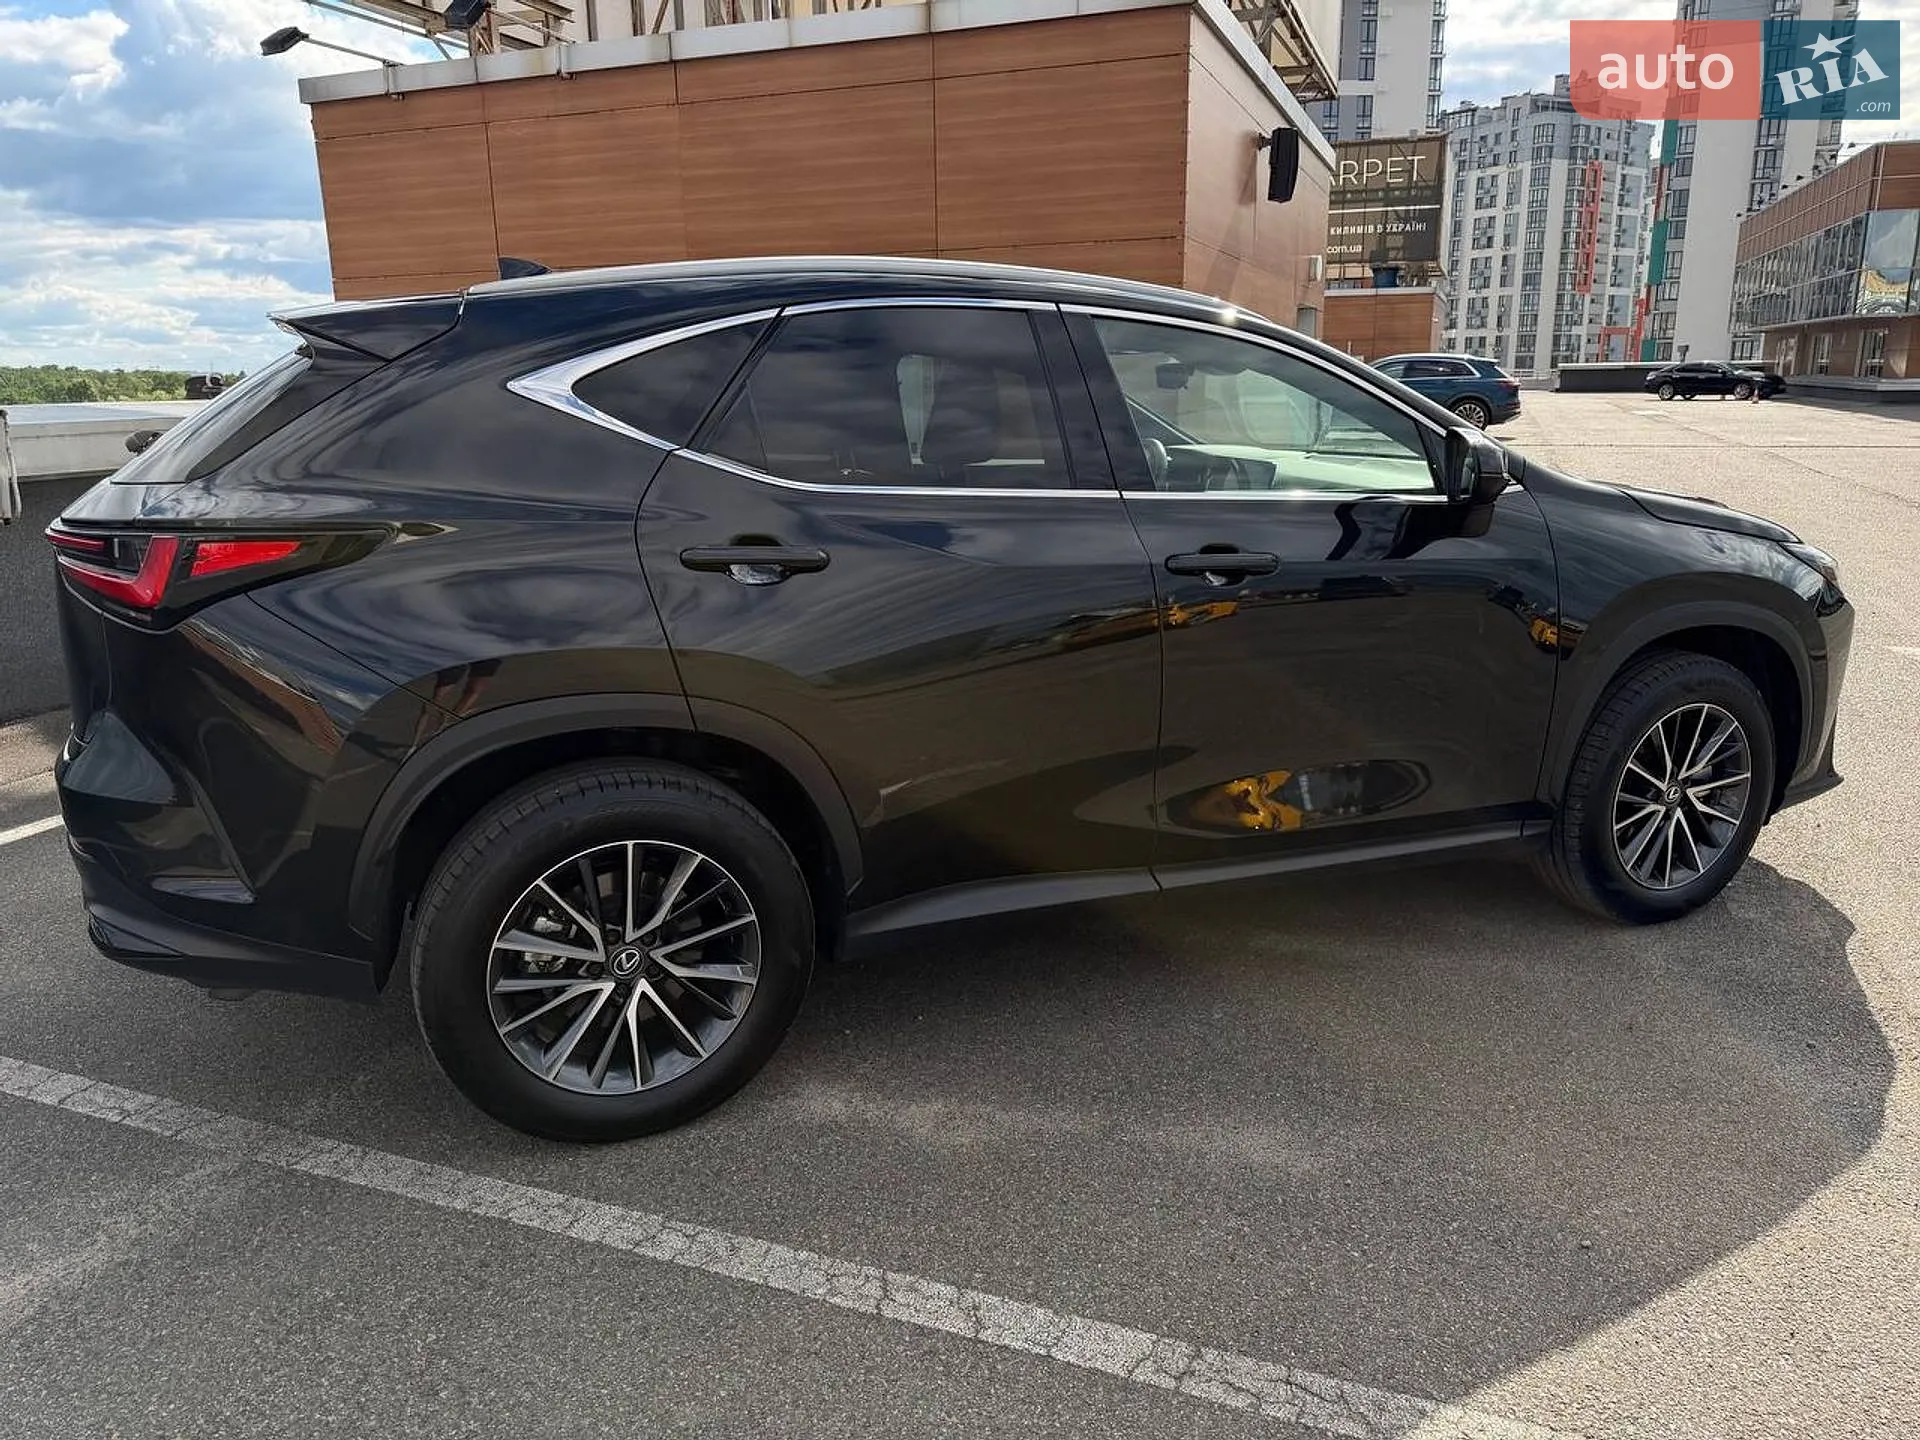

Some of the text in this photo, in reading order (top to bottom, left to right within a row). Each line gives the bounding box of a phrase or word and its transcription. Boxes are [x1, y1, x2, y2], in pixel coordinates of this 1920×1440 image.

[1329, 155, 1426, 186] RPET
[1330, 225, 1374, 236] КИЛИМІВ
[1386, 221, 1427, 234] УКРАЇНІ
